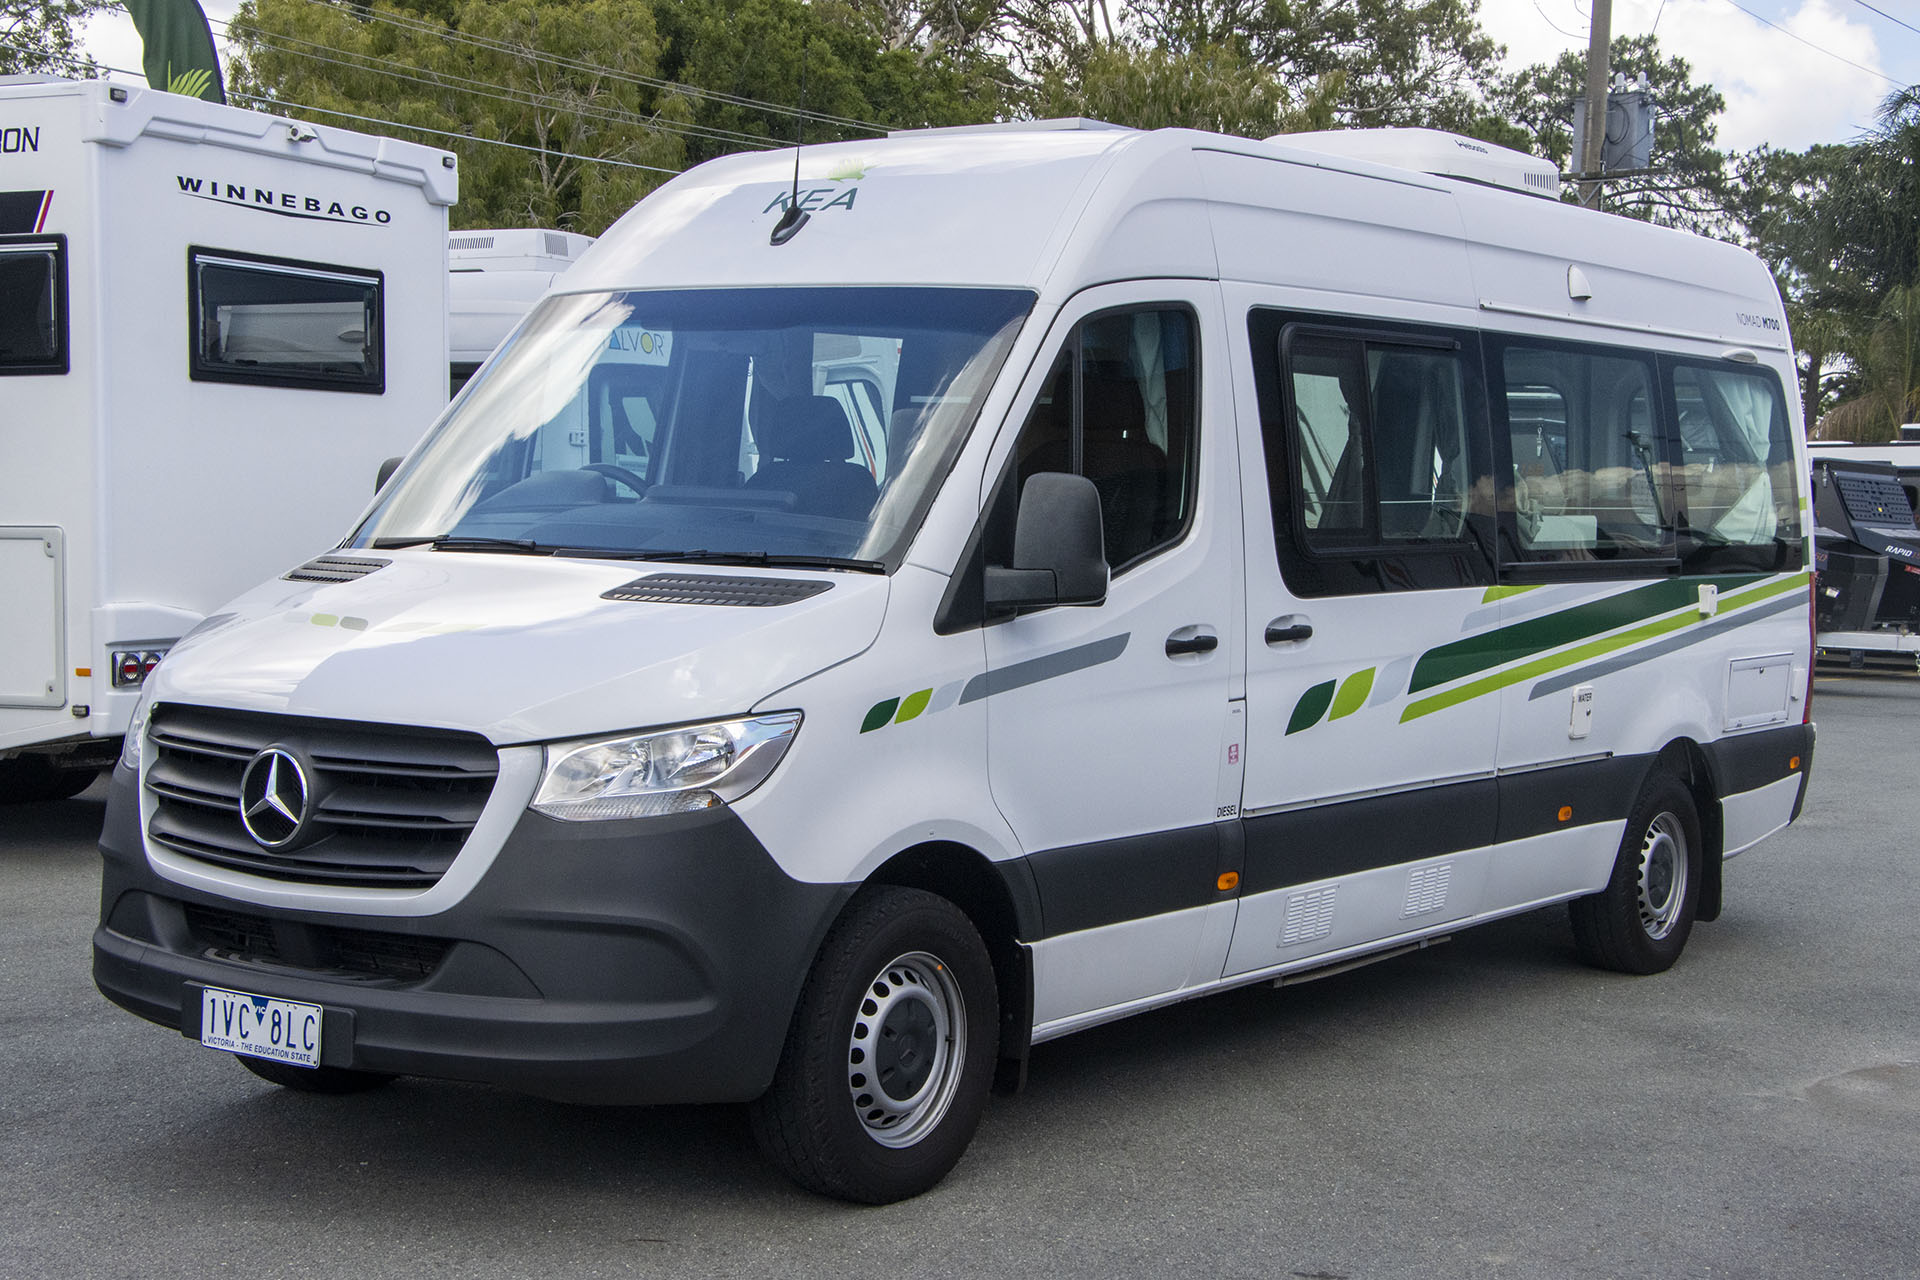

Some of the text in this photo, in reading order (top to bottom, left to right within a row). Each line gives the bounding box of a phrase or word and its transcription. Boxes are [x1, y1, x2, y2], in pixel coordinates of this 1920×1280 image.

[177, 176, 391, 223] WINNEBAGO
[762, 188, 858, 214] KEA
[1735, 312, 1780, 331] NOMAD M700
[1885, 545, 1913, 557] RAPID
[1578, 692, 1592, 703] WATER
[1216, 805, 1238, 818] DIESEL
[210, 998, 316, 1051] 1VC 8LC
[207, 1035, 235, 1048] VICTORIA
[241, 1042, 253, 1052] THE
[254, 1044, 289, 1059] EDUCATION
[291, 1052, 311, 1063] STATE
